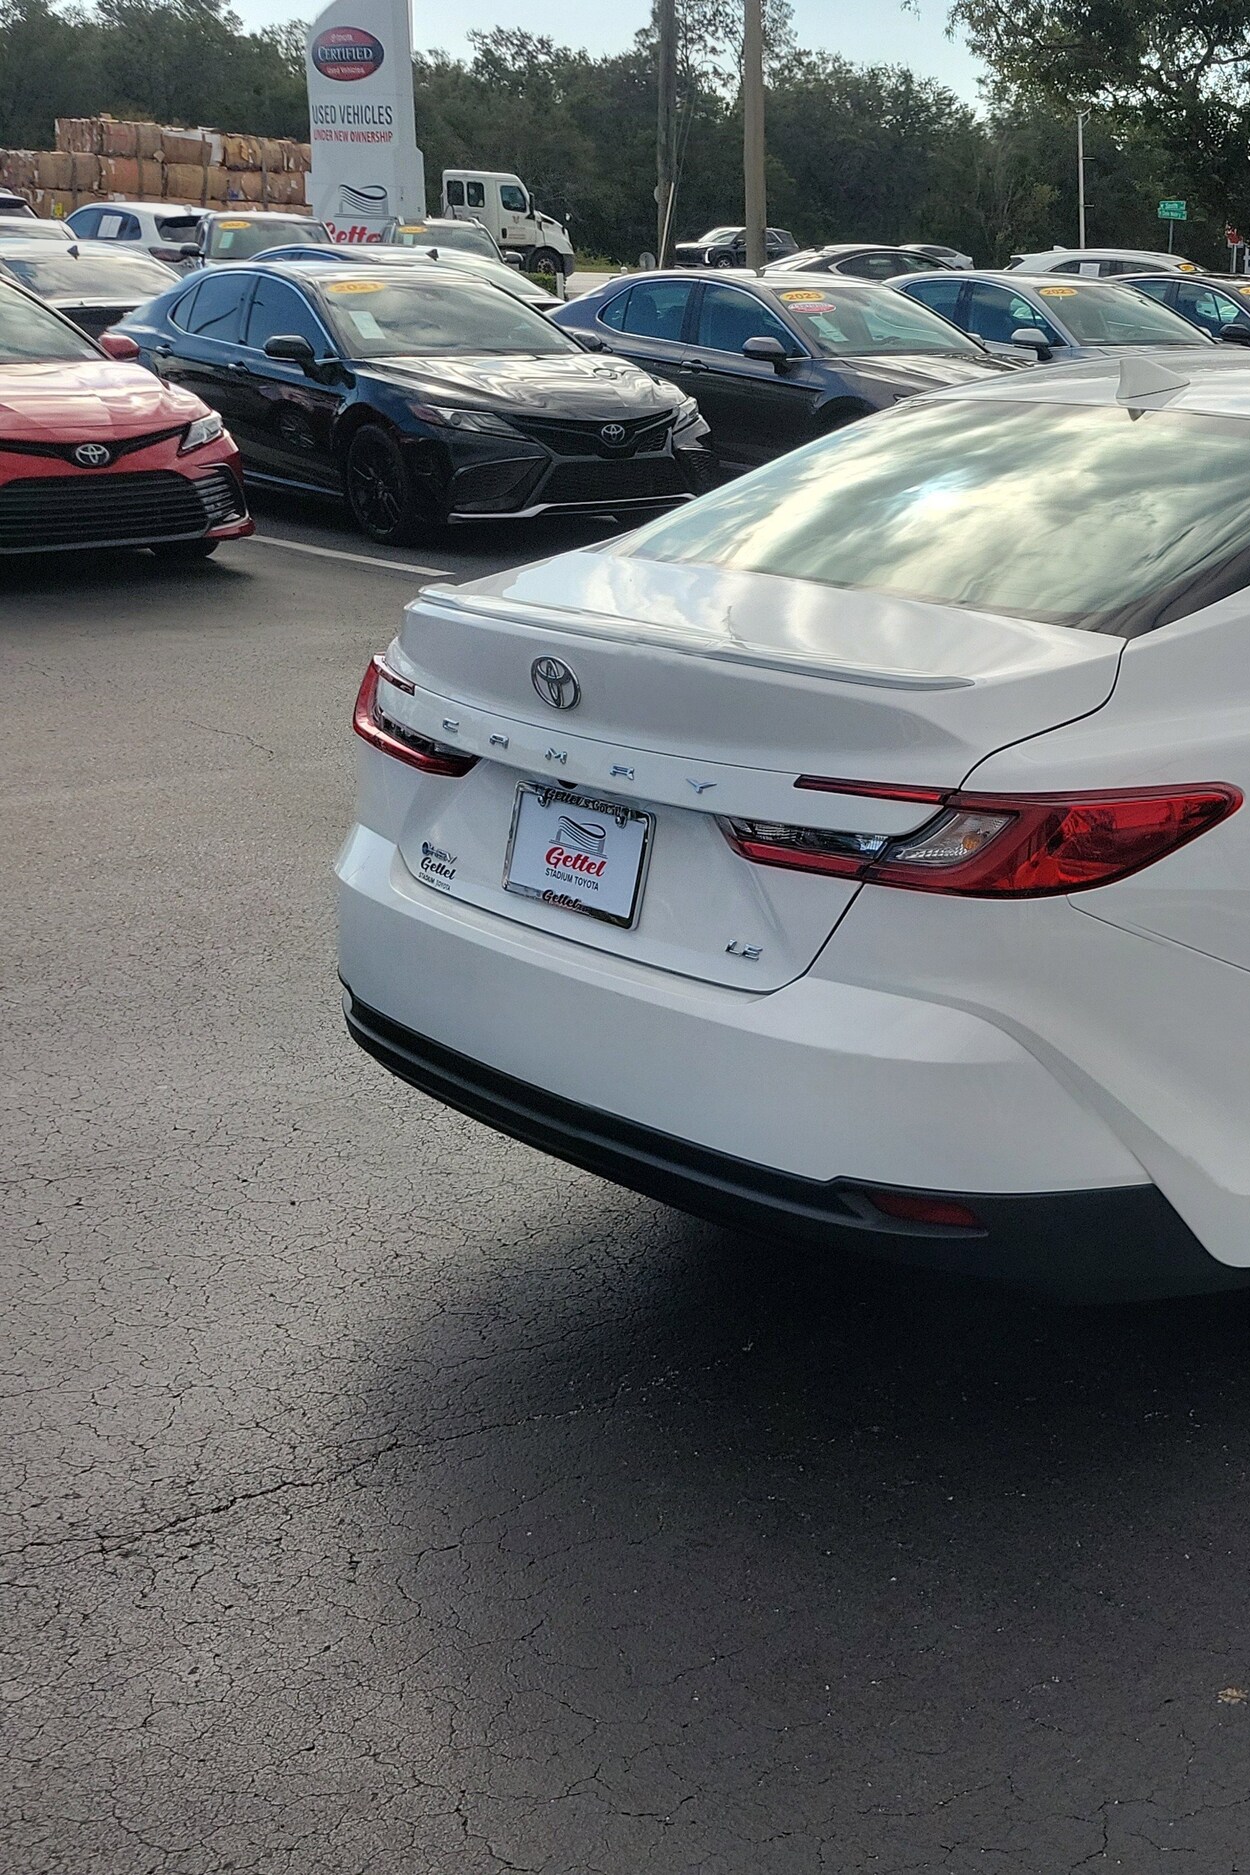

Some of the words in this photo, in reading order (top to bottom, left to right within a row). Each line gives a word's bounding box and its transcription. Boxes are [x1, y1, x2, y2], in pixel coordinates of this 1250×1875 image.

[318, 46, 373, 61] CERTIFIED
[312, 104, 336, 125] USED
[339, 105, 393, 125] VEHICLES
[314, 129, 333, 141] UNDER
[334, 130, 349, 141] NEW
[350, 131, 393, 143] OWNERSHIP
[442, 717, 717, 793] CAMRY
[420, 856, 456, 880] Gettel
[546, 847, 607, 877] Gettel
[545, 868, 573, 883] STADIUM
[574, 876, 599, 891] TOYOTA
[725, 939, 763, 961] LE
